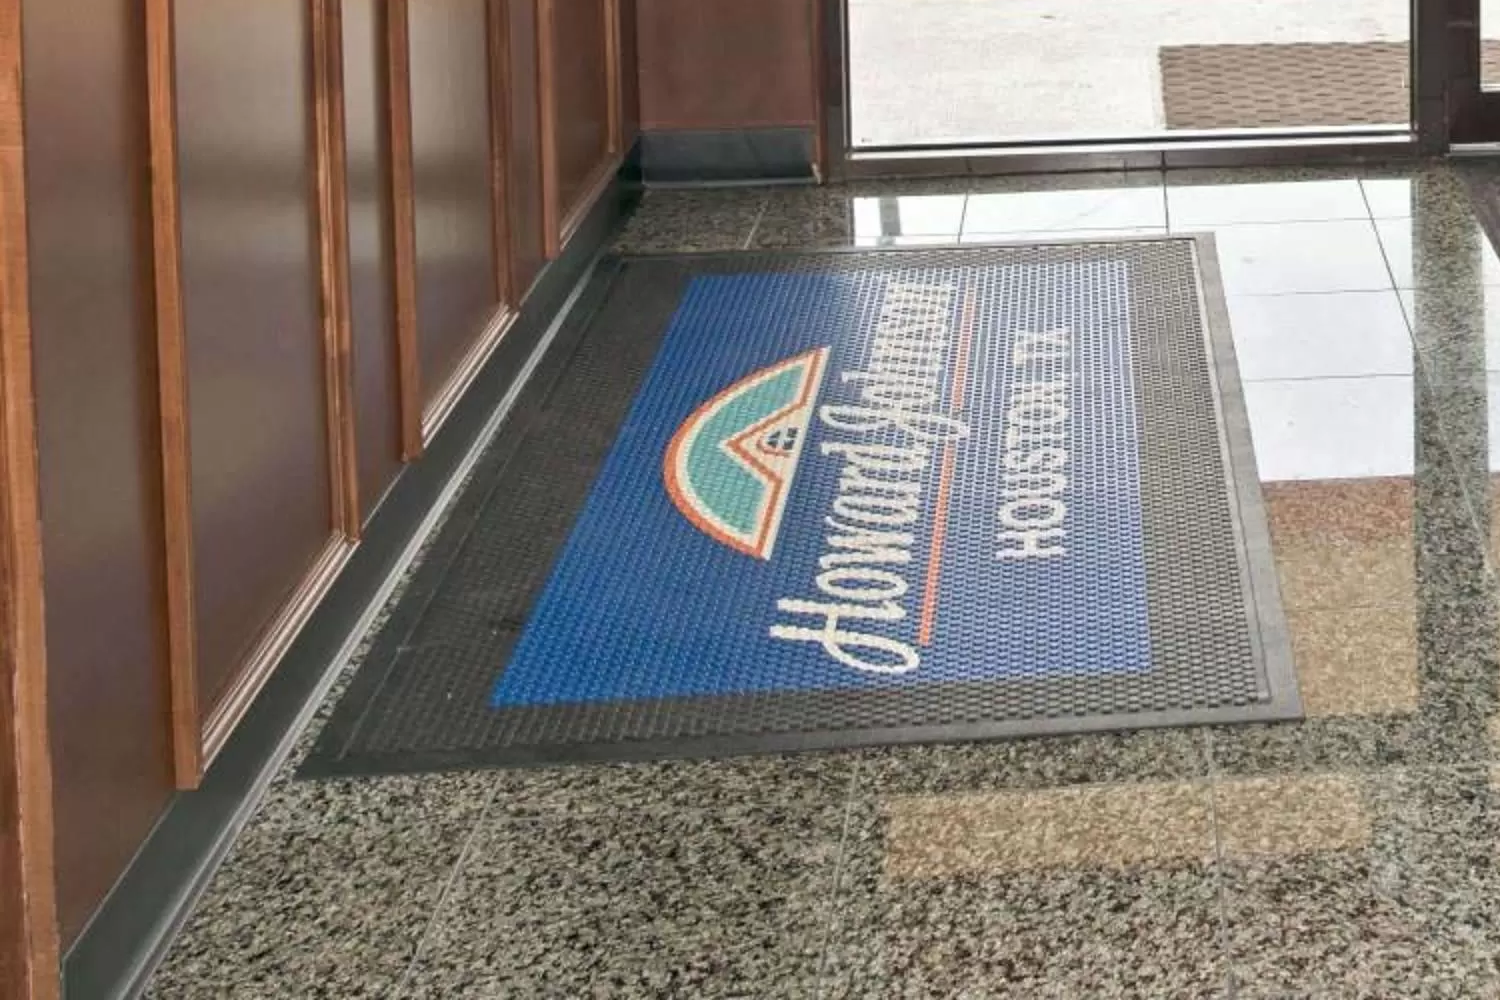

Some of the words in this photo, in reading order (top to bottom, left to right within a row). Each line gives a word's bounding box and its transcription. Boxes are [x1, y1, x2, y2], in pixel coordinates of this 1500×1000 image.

[819, 276, 969, 443] Johnson
[1013, 326, 1072, 367] TX
[768, 436, 932, 674] Howard
